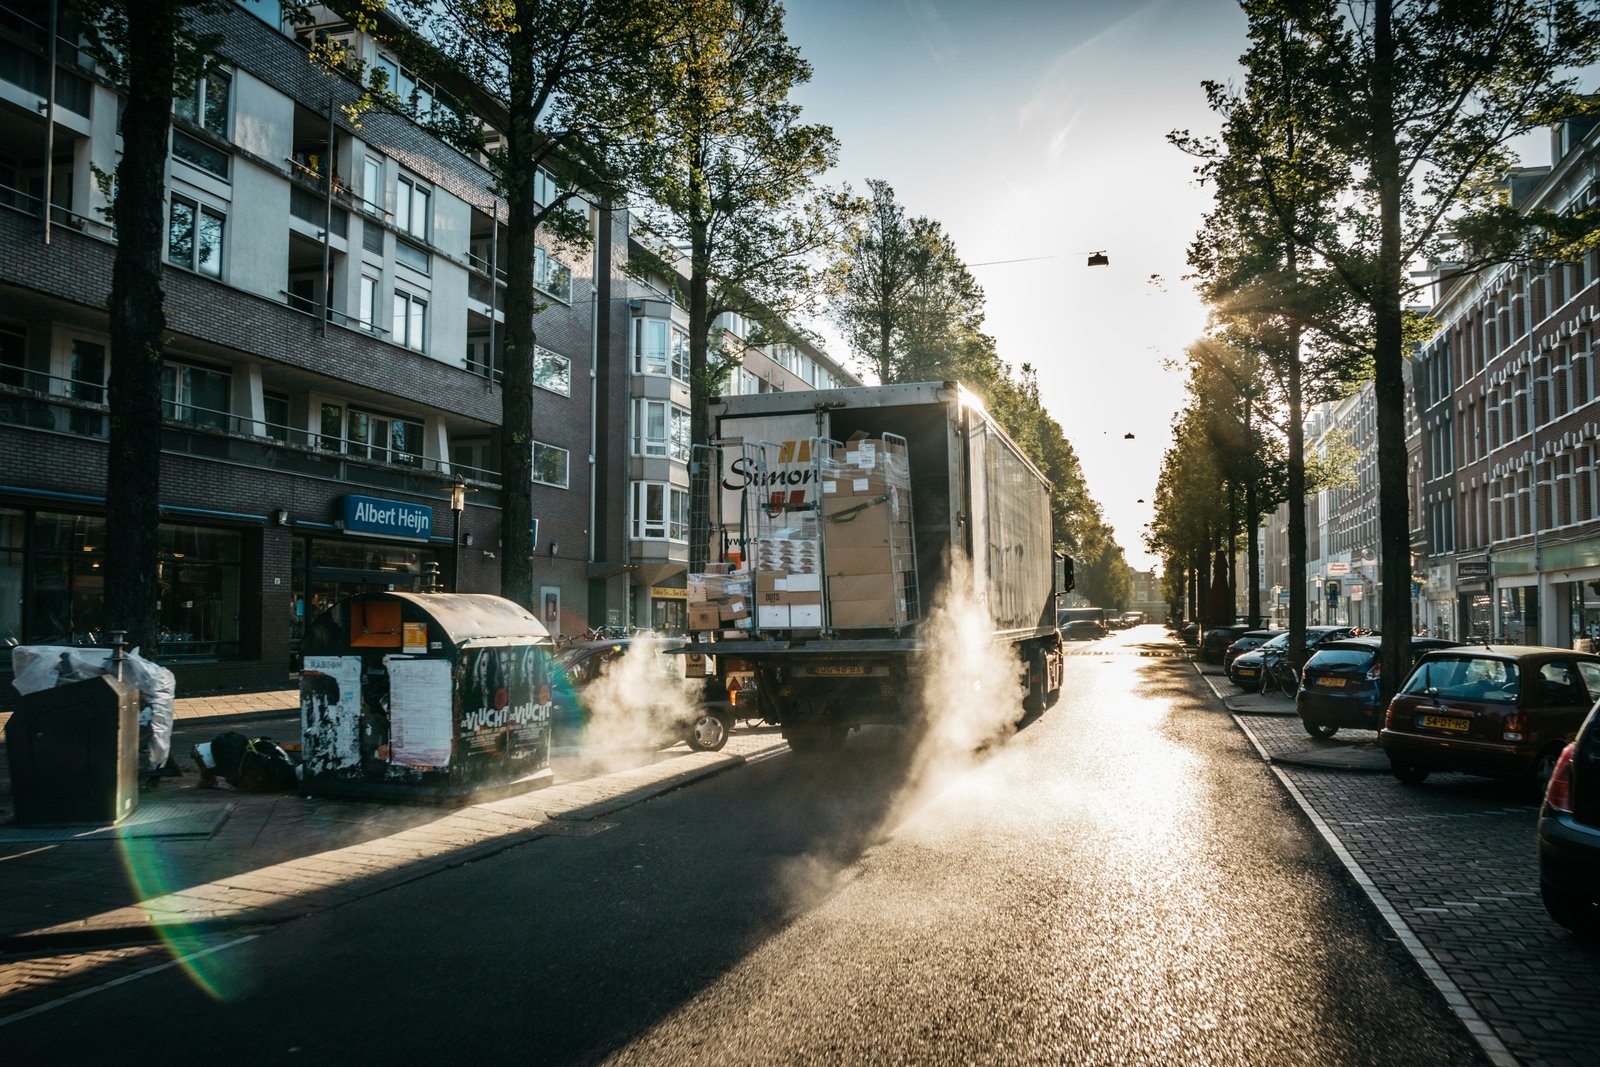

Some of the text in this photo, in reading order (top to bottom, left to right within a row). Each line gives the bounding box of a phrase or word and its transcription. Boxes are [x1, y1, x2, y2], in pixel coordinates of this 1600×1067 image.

[723, 457, 818, 490] Simon
[354, 502, 429, 533] Albert Heijn
[466, 705, 509, 731] VLUCHT
[514, 701, 552, 725] VLUCHT
[1426, 716, 1468, 730] 54-DT-HS
